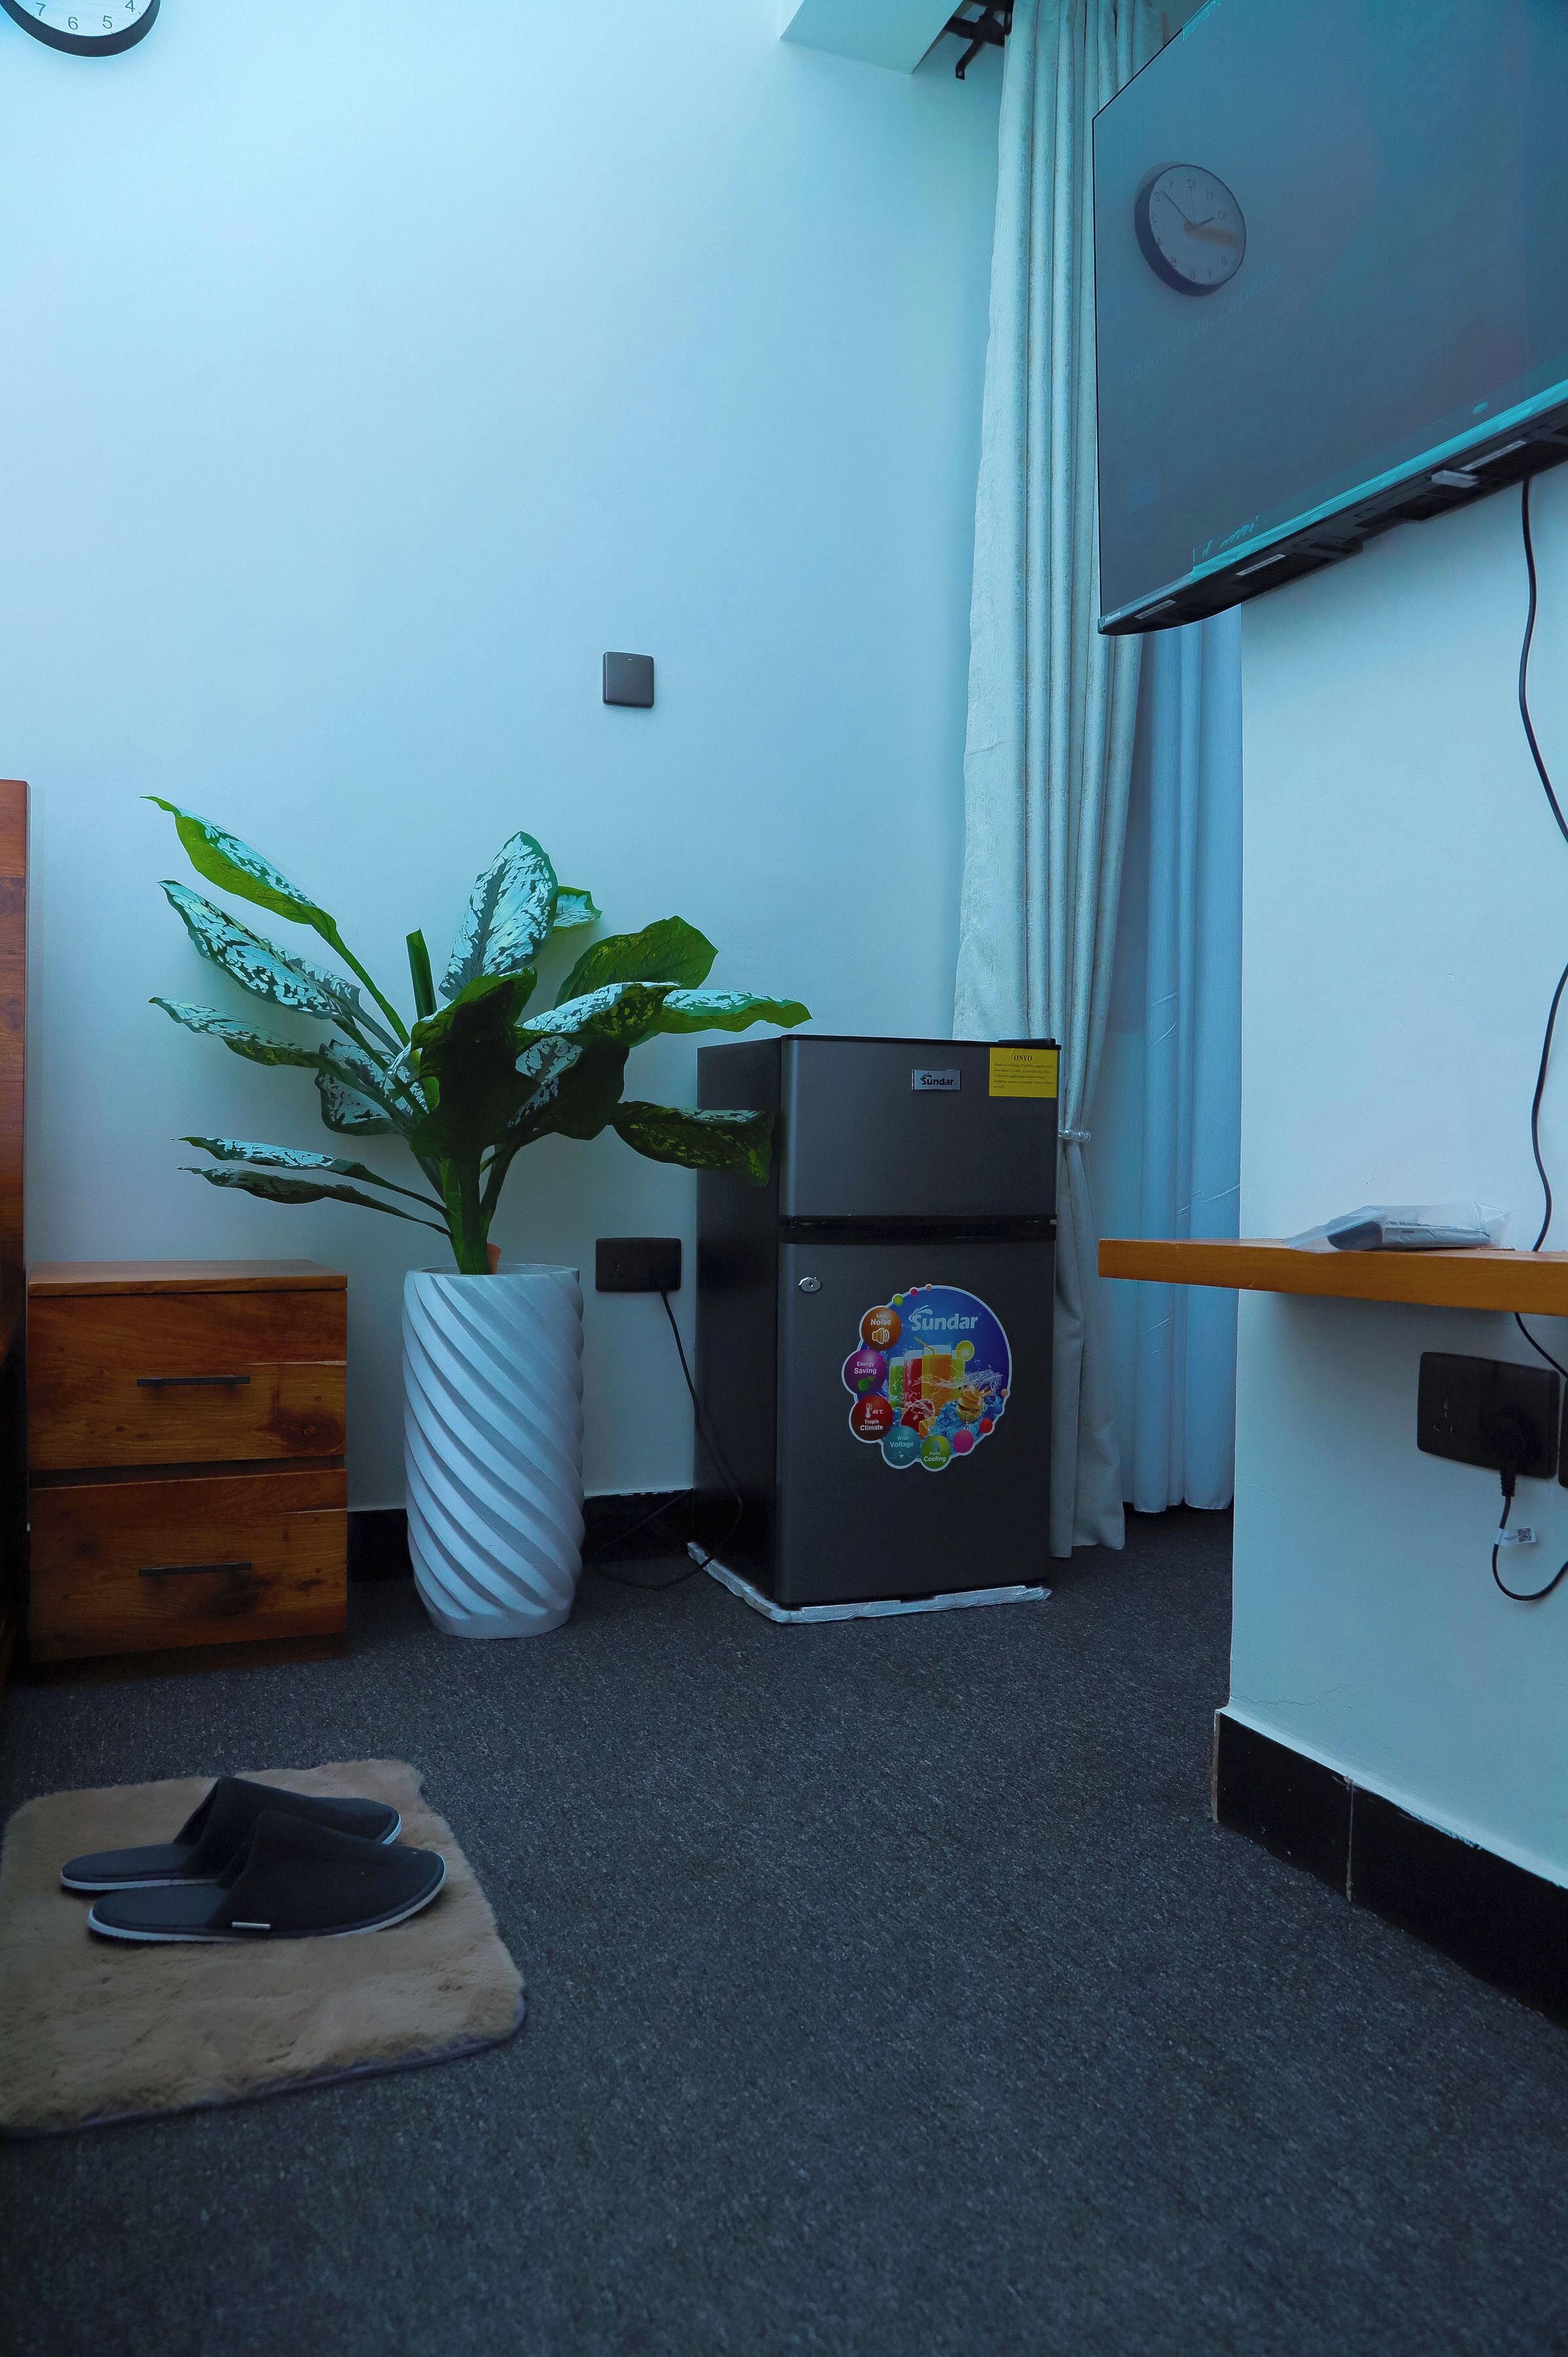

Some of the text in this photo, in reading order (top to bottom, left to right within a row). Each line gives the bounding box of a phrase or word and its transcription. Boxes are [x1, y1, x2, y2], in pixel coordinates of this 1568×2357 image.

[35, 2, 46, 16] 7
[124, 0, 136, 12] 4
[67, 16, 79, 30] 6
[102, 15, 113, 29] 5
[1104, 611, 1121, 623] Hisense
[921, 1074, 955, 1086] Sundar
[909, 1309, 978, 1331] Sundar
